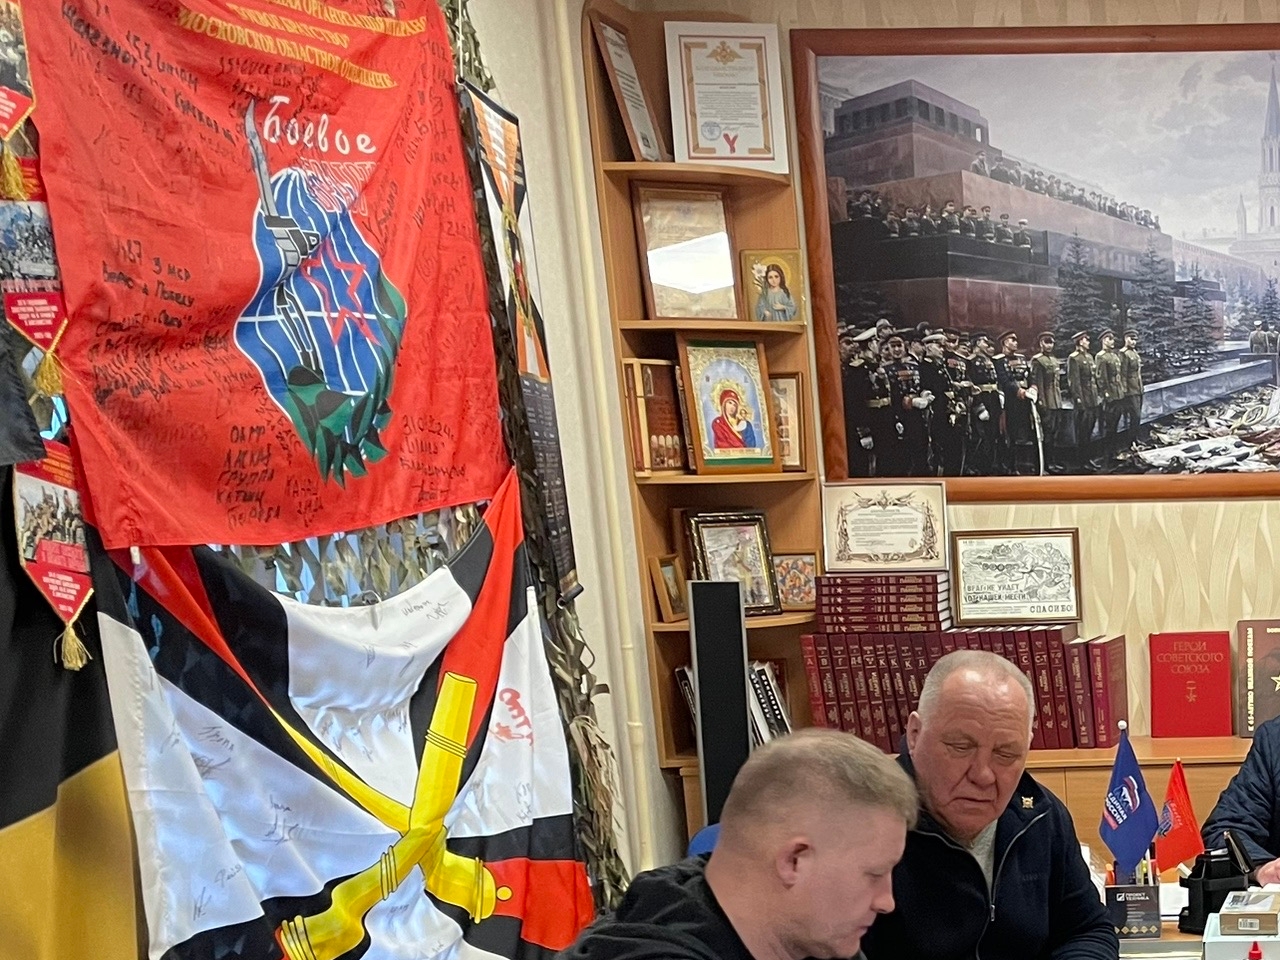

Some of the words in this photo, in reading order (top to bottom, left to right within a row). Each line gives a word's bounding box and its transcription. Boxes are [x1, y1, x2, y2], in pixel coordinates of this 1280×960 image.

[180, 10, 275, 55] МОСКОВСКОЕ
[264, 94, 377, 155] Боевое
[1156, 652, 1224, 663] СОВЕТСКОГО
[1173, 641, 1207, 651] ГЕРОИ
[1246, 627, 1254, 658] ПОБЕДЫ
[1171, 664, 1210, 674] СОЮЗА
[1246, 656, 1254, 690] ВЕЛИКОЙ
[1108, 792, 1128, 821] ЕДИНАЯ
